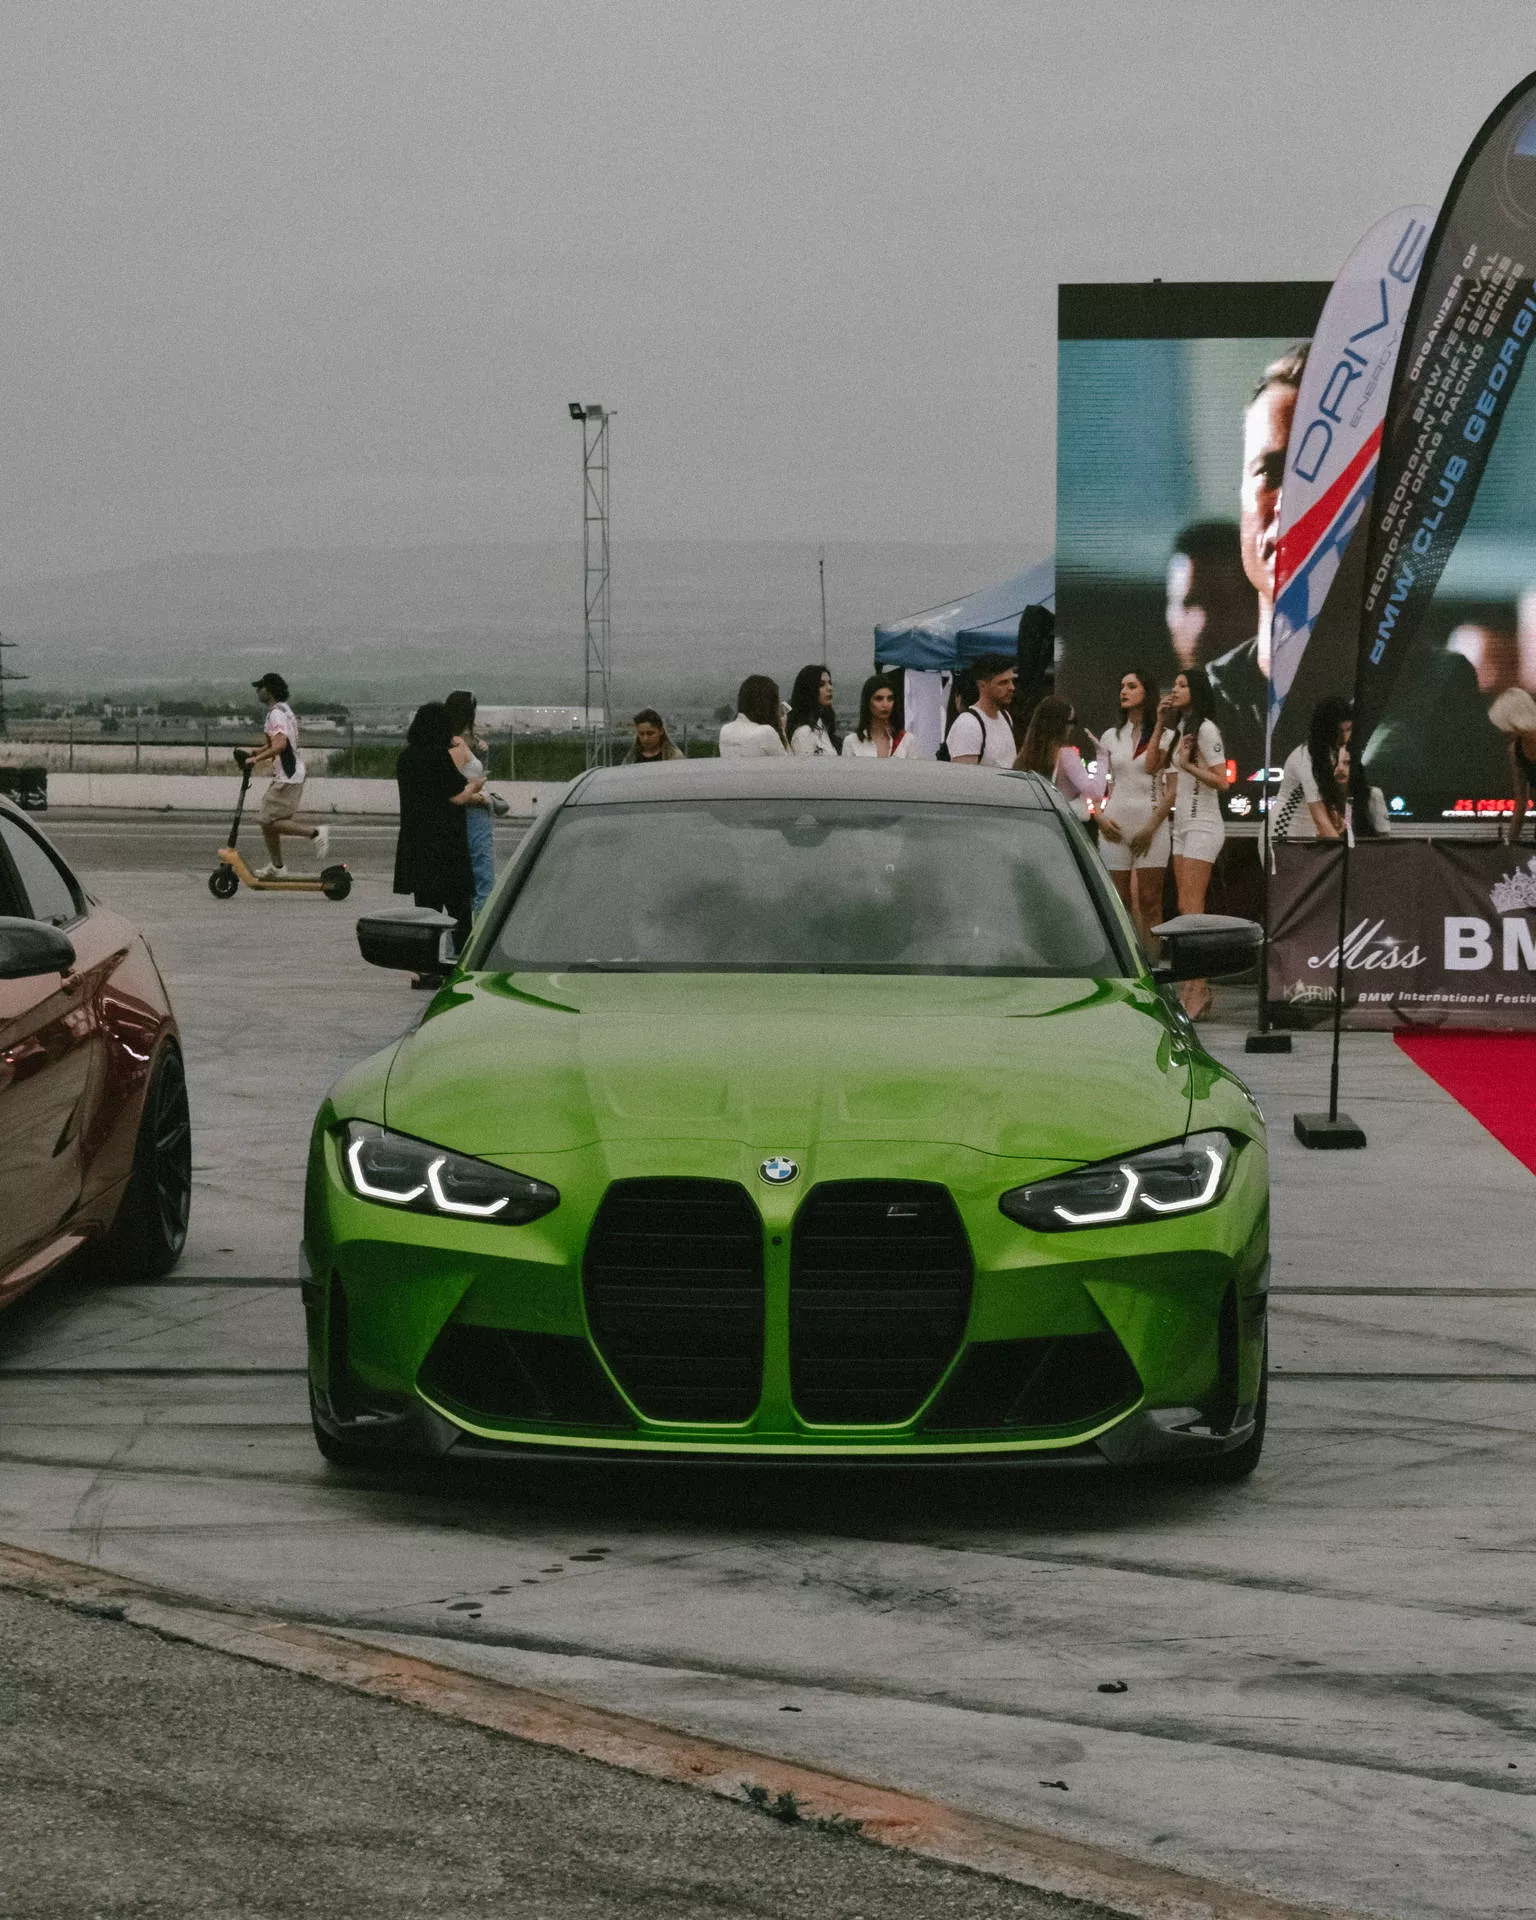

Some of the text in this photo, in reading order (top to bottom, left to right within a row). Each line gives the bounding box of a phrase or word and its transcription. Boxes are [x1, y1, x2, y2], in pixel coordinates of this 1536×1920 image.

[1291, 218, 1428, 484] DRIVE
[1380, 256, 1512, 533] GEORGIAN DRIFT SERIES
[1410, 243, 1478, 381] ORGANIZER OF
[1412, 253, 1499, 423] BMW FESTIVAL
[1364, 262, 1525, 612] GEORGIAN DRAG RACING SERIES
[1369, 279, 1536, 666] BMW CLUB GEORGI
[1307, 918, 1427, 970] Miss
[1358, 991, 1395, 1003] BMW
[1398, 991, 1490, 1004] International
